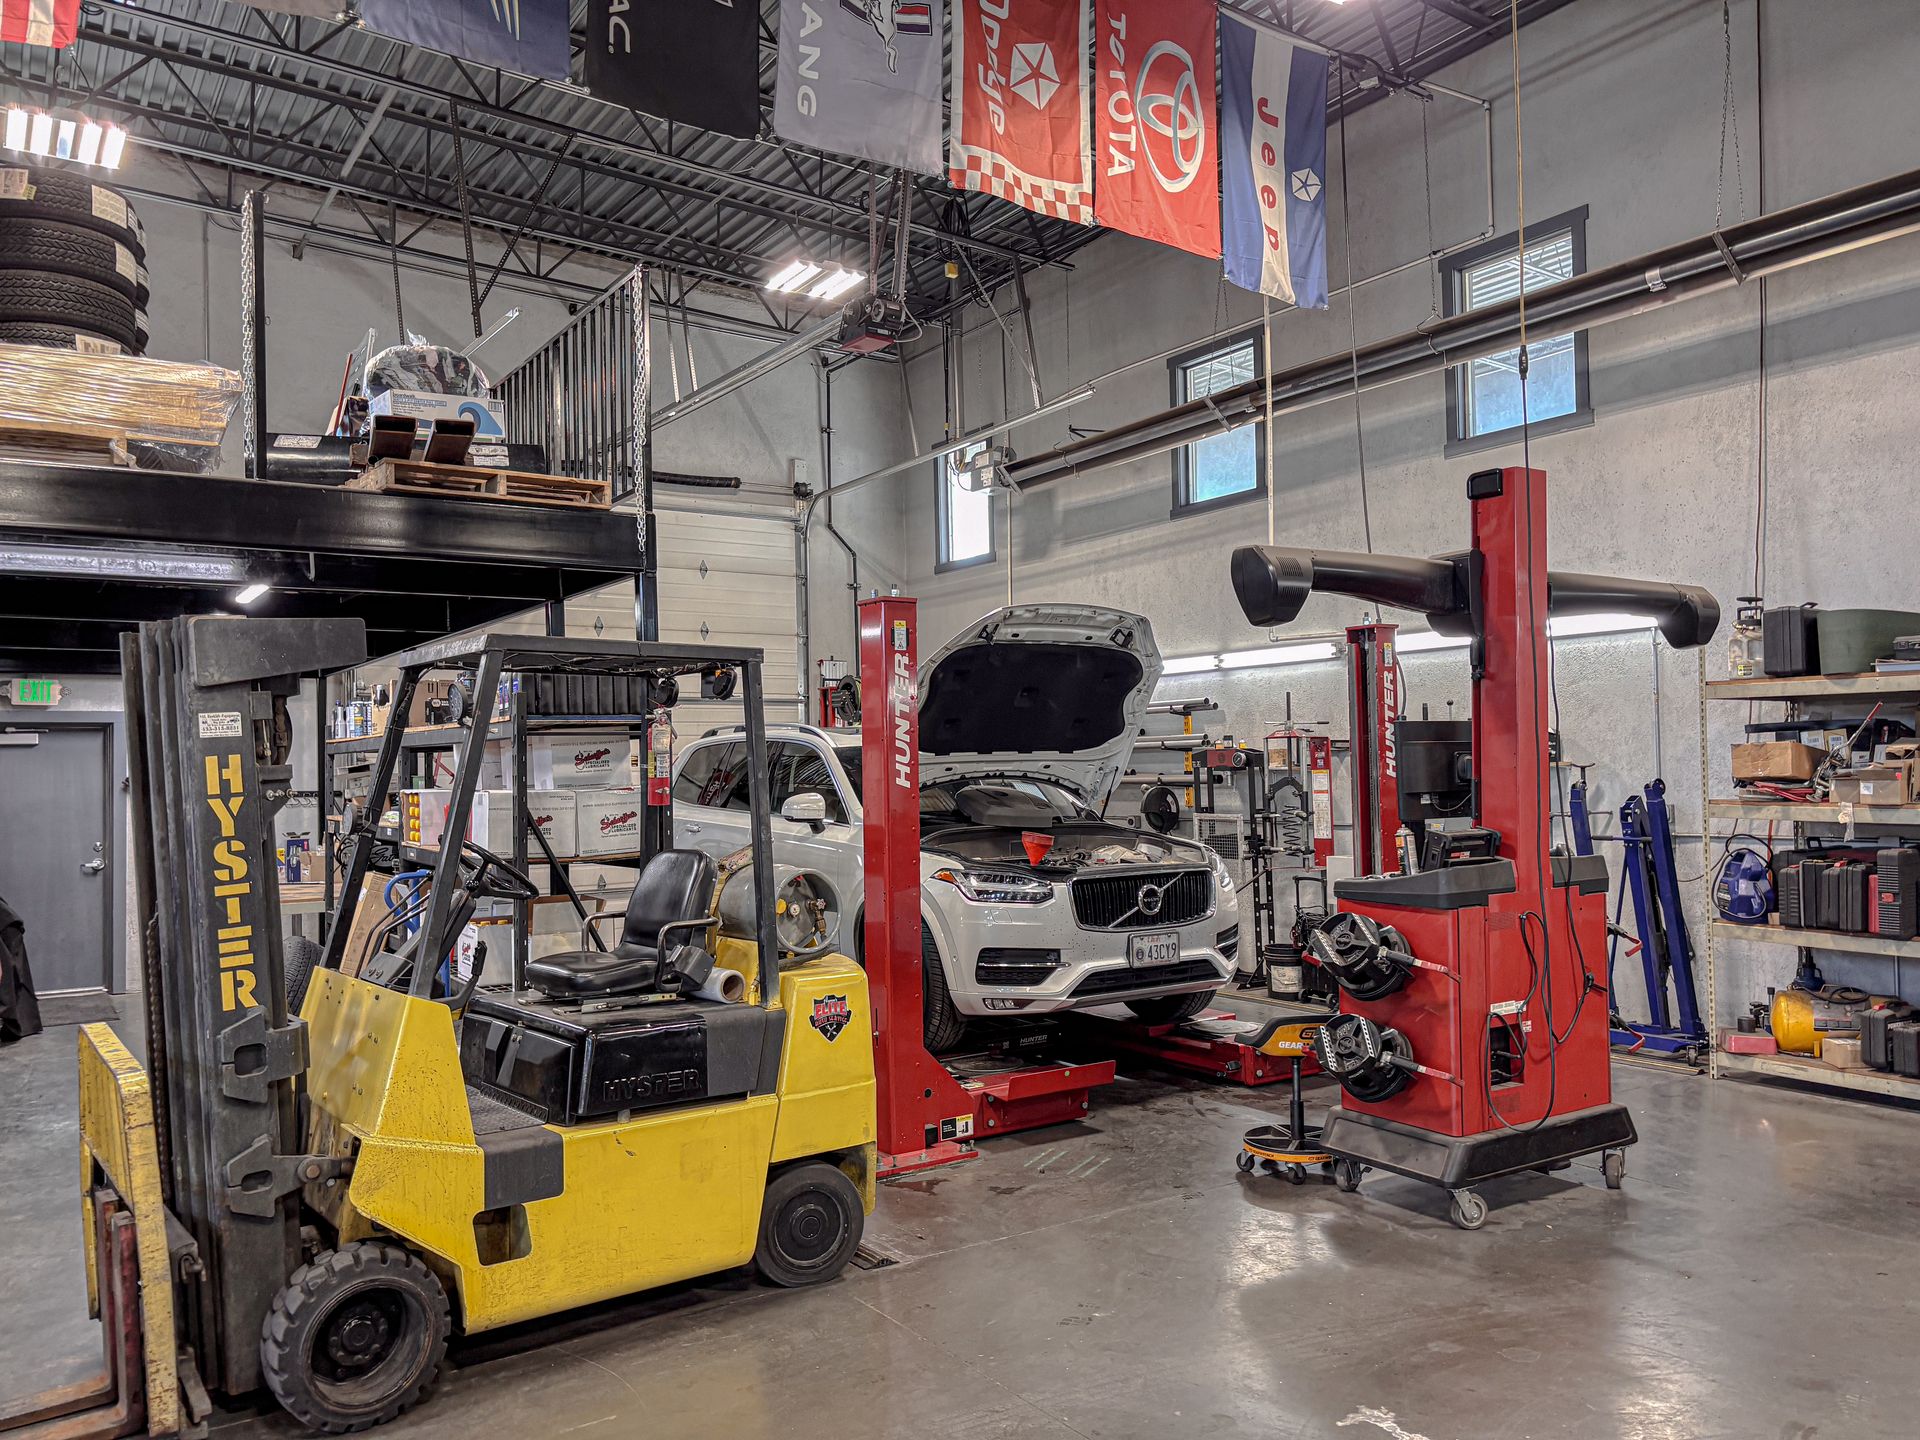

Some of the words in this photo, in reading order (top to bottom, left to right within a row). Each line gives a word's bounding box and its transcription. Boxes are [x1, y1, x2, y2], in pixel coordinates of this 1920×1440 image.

[797, 2, 823, 117] ANG
[1257, 97, 1280, 251] Jeep
[19, 680, 53, 704] EXIT
[894, 653, 911, 789] HUNTER
[1384, 670, 1397, 778] HUNTER
[205, 753, 260, 1012] HYSTER
[1147, 942, 1177, 960] 43CY9
[814, 1001, 848, 1020] ELITE
[1020, 1034, 1048, 1043] HUNTER
[1278, 1041, 1310, 1051] GEAR
[603, 1069, 701, 1100] HYSTER
